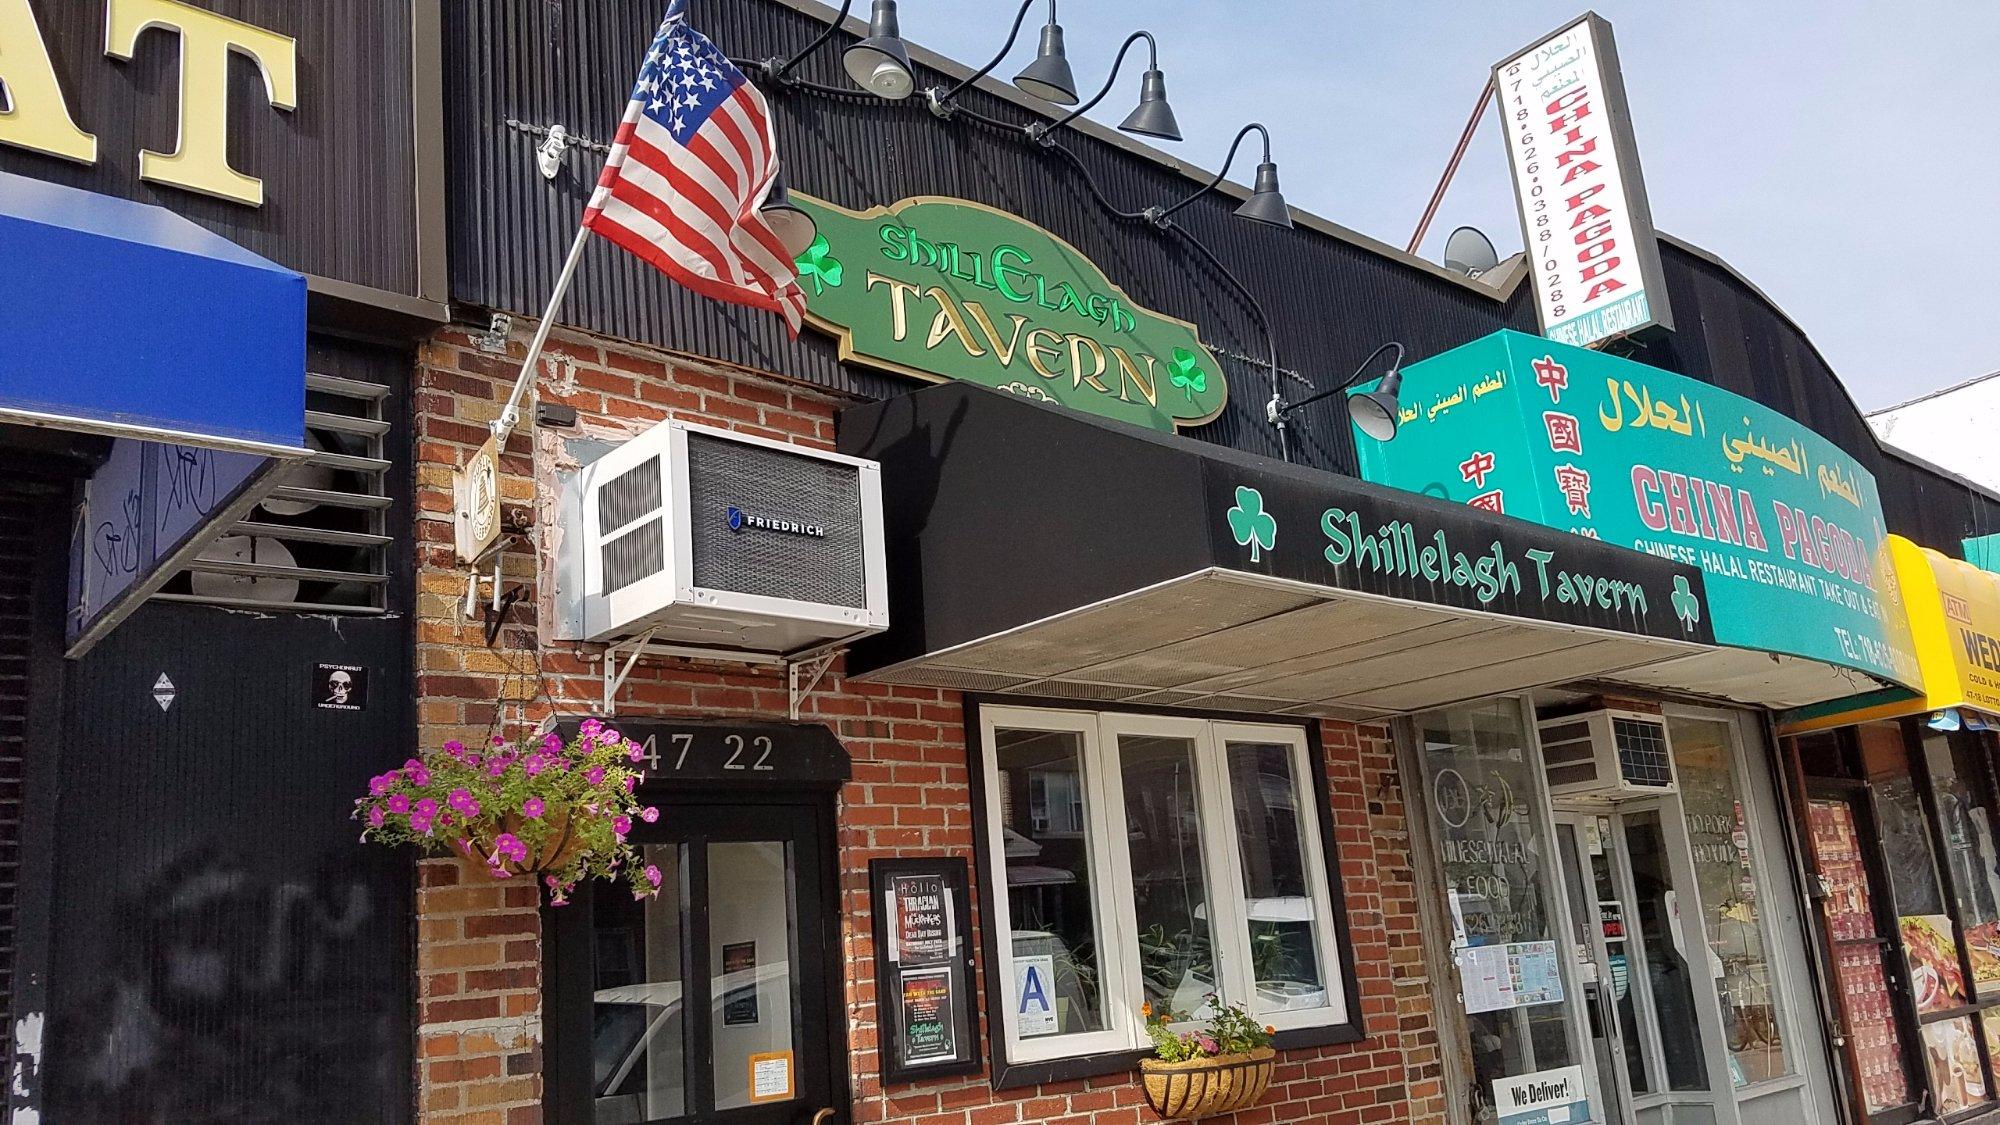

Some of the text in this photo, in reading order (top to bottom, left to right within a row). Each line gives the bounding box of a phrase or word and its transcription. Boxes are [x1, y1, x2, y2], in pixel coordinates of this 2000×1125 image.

[1546, 85, 1627, 304] CHINA PAGODA
[866, 269, 1157, 409] TAVERN
[748, 515, 824, 537] FRIEDRICH
[1631, 464, 1768, 552] CHINA
[1772, 499, 1878, 594] PAGODA
[1320, 507, 1648, 615] Shillelagh Tavern
[1700, 549, 1748, 579] HALAL
[1750, 559, 1818, 597] RESTAURANT
[1819, 578, 1843, 606] TAKE
[1843, 587, 1861, 612] OUT
[1946, 597, 1970, 623] ATM
[1969, 674, 1987, 686] COLD
[317, 702, 361, 711] UNDERGROUND
[641, 733, 774, 770] 47 22
[1705, 814, 1733, 835] PORK
[1467, 875, 1511, 899] FOOD
[1019, 966, 1050, 1013] A
[1511, 1078, 1569, 1107] We Deliver!
